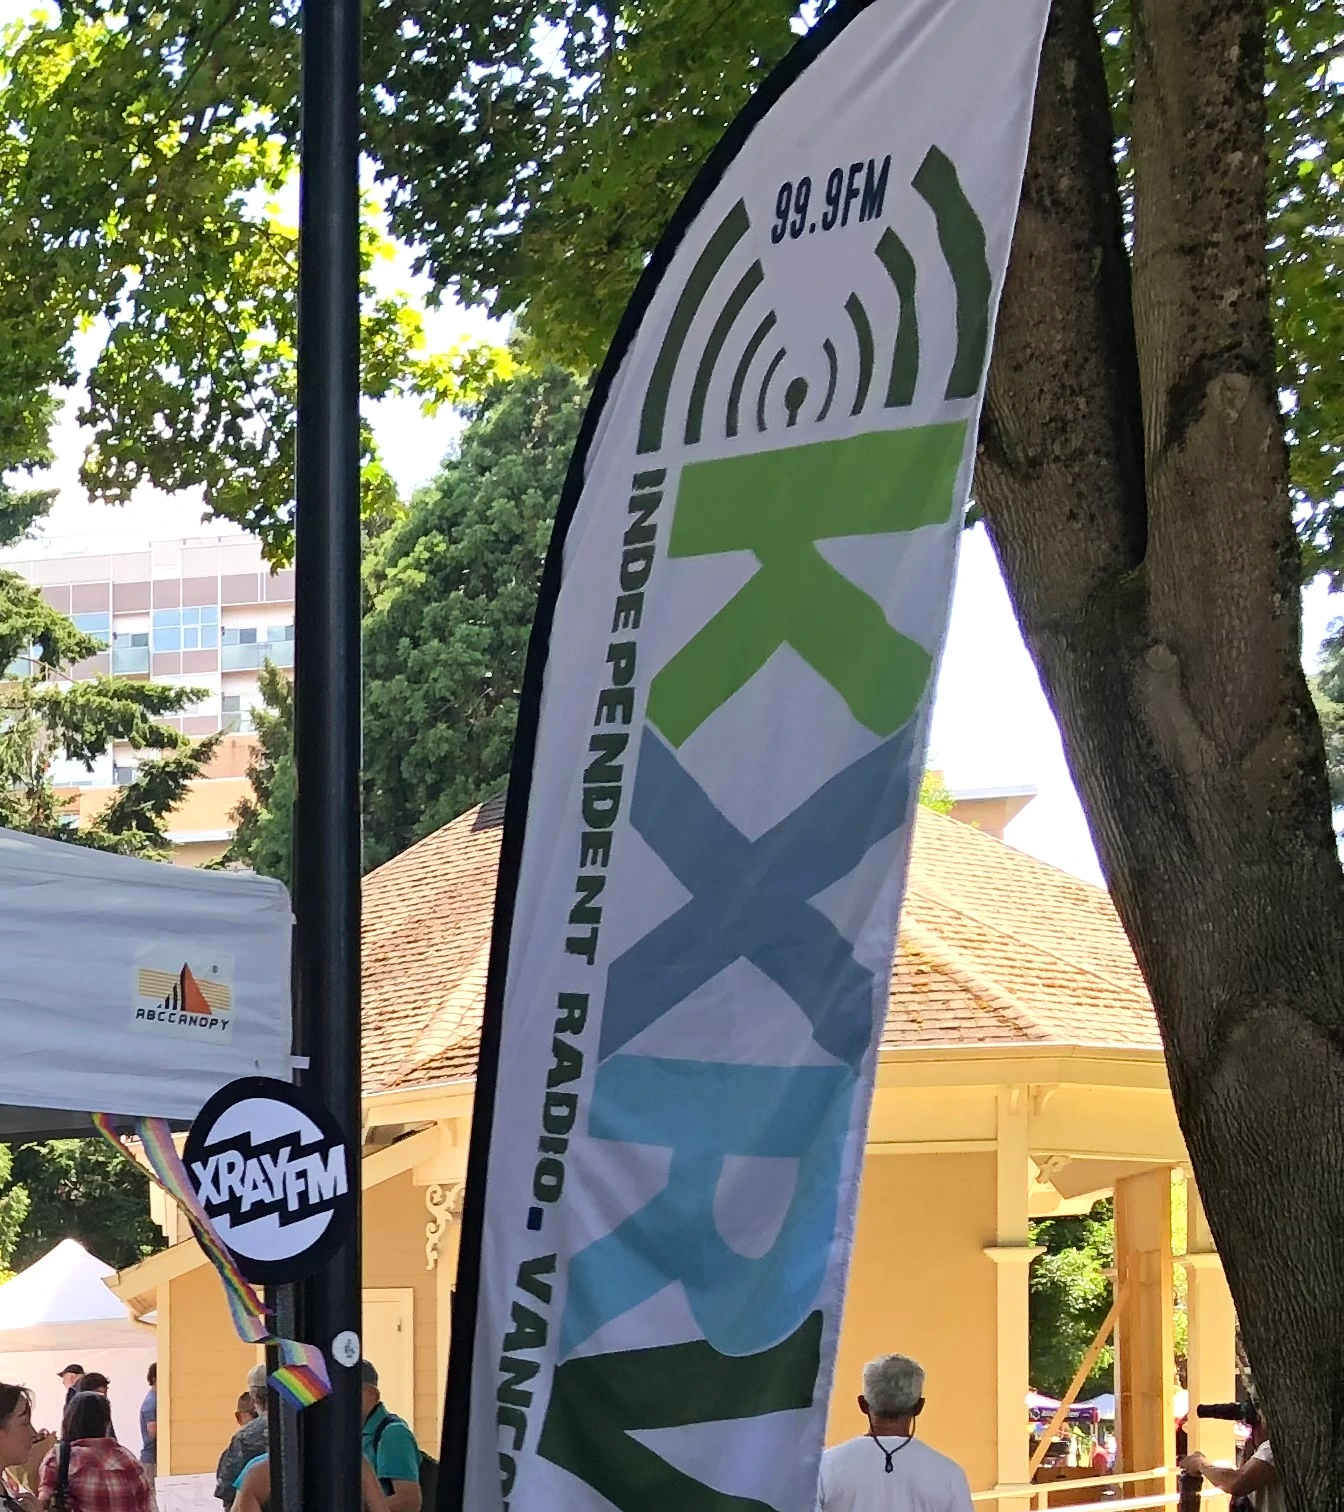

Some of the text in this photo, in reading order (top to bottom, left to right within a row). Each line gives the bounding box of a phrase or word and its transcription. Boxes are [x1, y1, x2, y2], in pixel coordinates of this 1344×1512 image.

[771, 154, 893, 244] 99.9FM
[564, 467, 667, 967] INDEPENDENT
[135, 1008, 230, 1031] ABCCANOPY
[526, 991, 587, 1232] RADIO.
